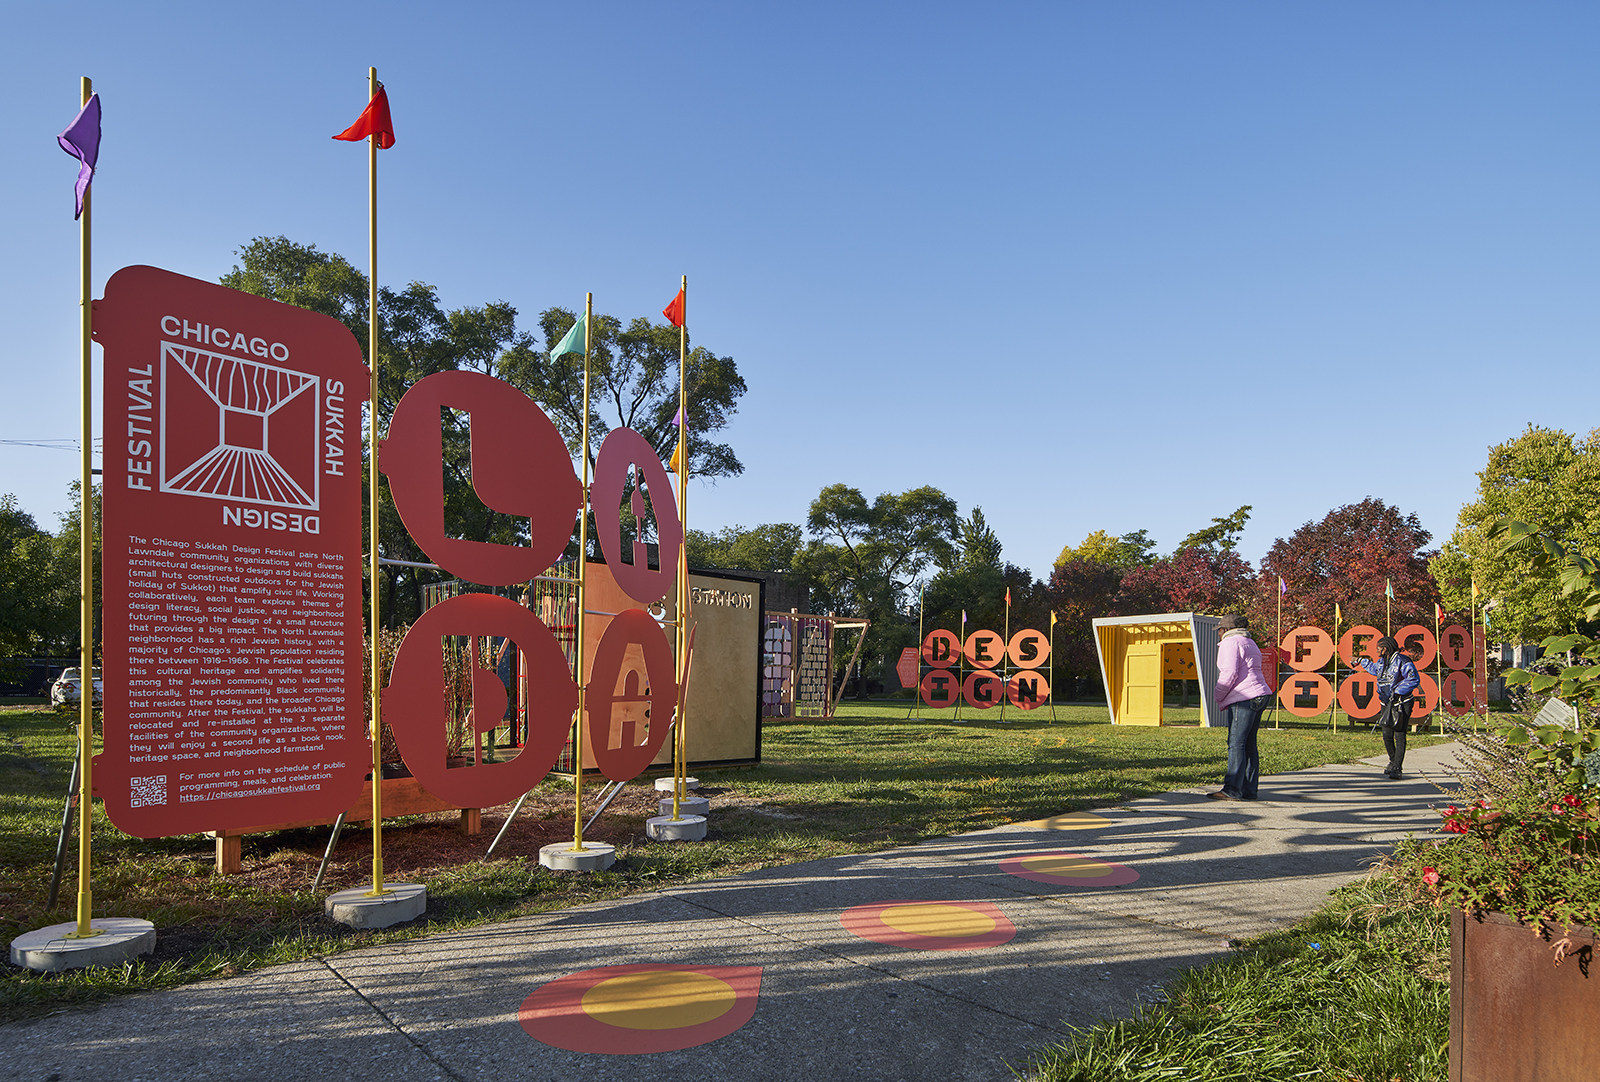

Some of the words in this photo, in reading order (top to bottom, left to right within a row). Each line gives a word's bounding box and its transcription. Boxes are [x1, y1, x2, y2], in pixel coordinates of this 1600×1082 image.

[161, 316, 289, 362] CHICAGO
[128, 364, 152, 491] FESTIVAL
[326, 378, 344, 476] SUKKAH
[223, 506, 320, 534] DESIGN
[128, 535, 147, 544] The
[152, 538, 190, 549] Chicago
[195, 542, 228, 551] Sukkah
[232, 545, 261, 555] Design
[265, 548, 295, 556] Festival
[128, 547, 174, 557] Lawndale
[180, 552, 229, 563] community
[234, 557, 290, 566] organizations
[128, 559, 188, 568] architectural
[190, 562, 232, 572] designers
[246, 566, 273, 576] design
[128, 569, 157, 577] (small
[162, 571, 183, 579] huts
[187, 574, 240, 582] constructed
[244, 577, 281, 585] outdoors
[128, 580, 163, 590] holiday
[180, 582, 216, 593] Sukkot)
[240, 587, 271, 596] amplify
[312, 590, 344, 600] Working
[128, 591, 198, 602] collaboratively,
[336, 599, 344, 608] of
[692, 587, 752, 609] STATION
[128, 602, 160, 611] design
[166, 603, 202, 613] literacy,
[238, 606, 267, 615] justice,
[292, 609, 344, 617] neighborhood
[209, 626, 223, 634] big
[227, 626, 257, 634] impact.
[128, 635, 193, 643] neighborhood
[284, 638, 313, 646] history,
[128, 646, 168, 655] majority
[315, 648, 344, 656] residing
[200, 667, 236, 676] heritage
[267, 667, 303, 675] amplifies
[310, 667, 345, 675] solidarity
[227, 677, 273, 685] community
[129, 689, 182, 697] historically,
[210, 687, 271, 696] predominantly
[303, 686, 345, 697] community
[216, 698, 243, 706] today,
[129, 710, 183, 719] community.
[129, 721, 173, 729] relocated
[208, 718, 256, 726] re-installed
[312, 714, 345, 722] separate
[129, 732, 169, 740] facilities
[210, 728, 257, 737] community
[262, 726, 317, 735] organizations,
[129, 754, 168, 762] heritage
[172, 753, 201, 761] space,
[223, 746, 281, 757] neighborhood
[283, 744, 325, 752] farmstand.
[274, 764, 309, 773] schedule
[323, 761, 345, 770] public
[180, 780, 240, 792] programming,
[242, 777, 268, 785] meals,
[180, 784, 320, 803] https://chicagosukkahfestival.org
